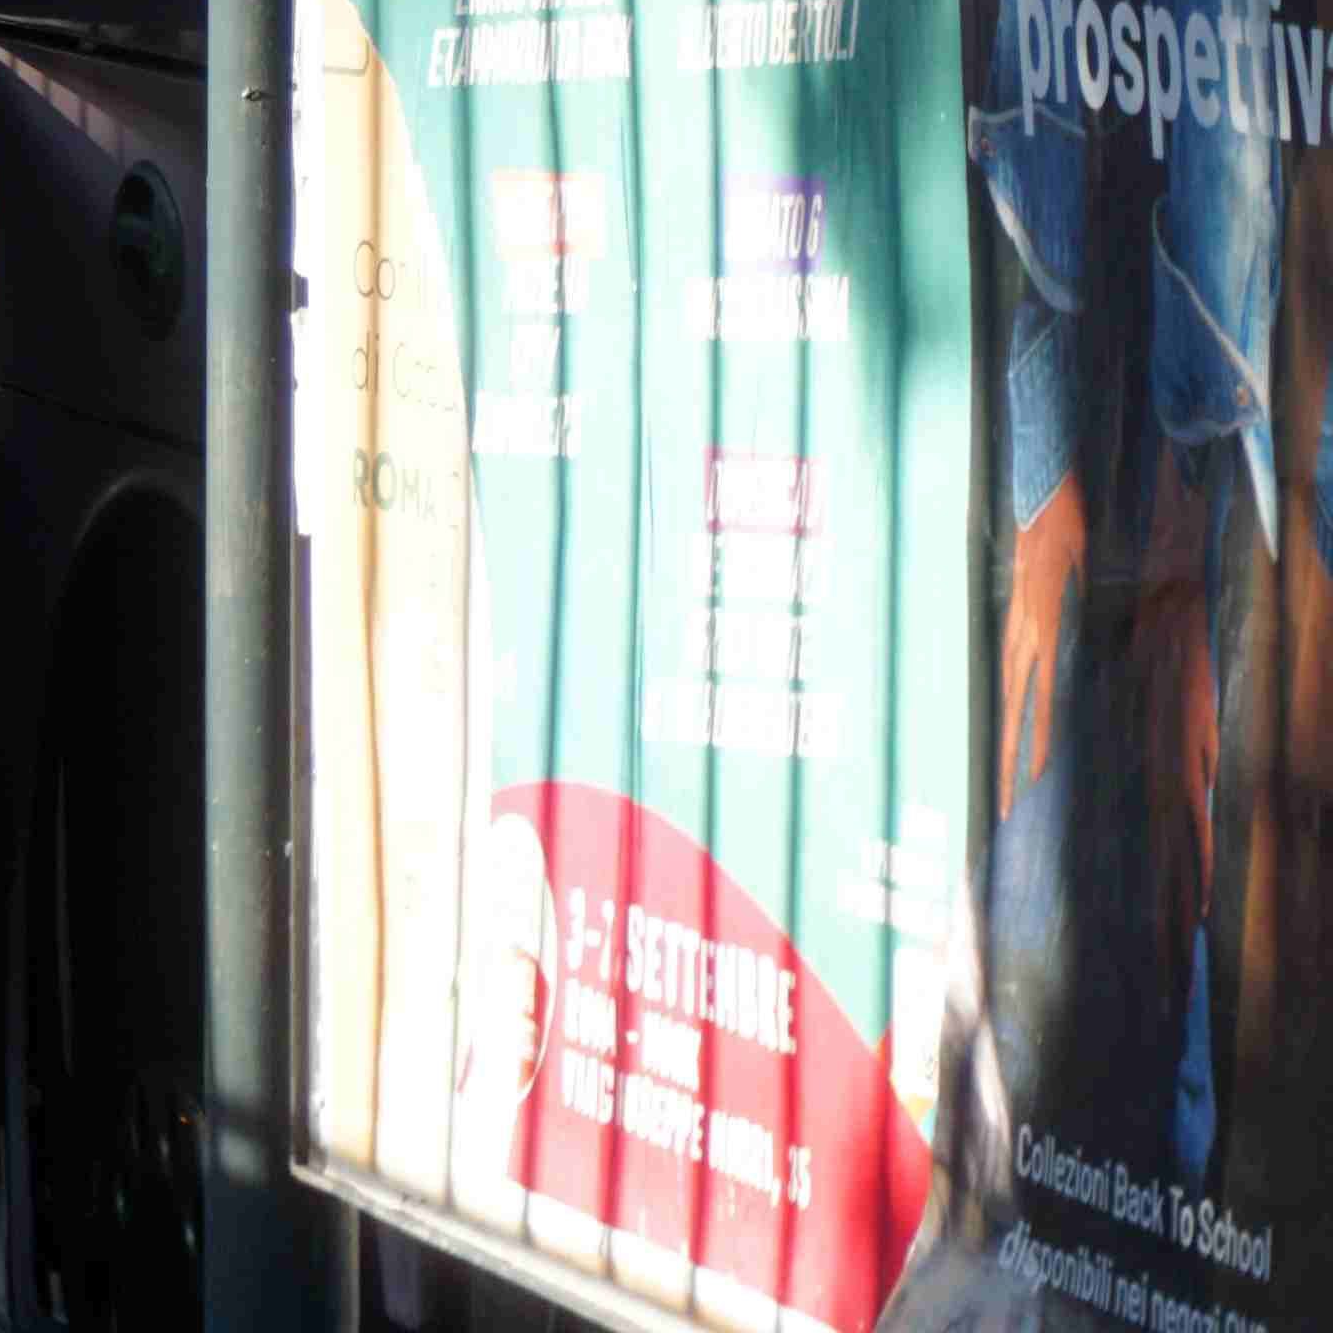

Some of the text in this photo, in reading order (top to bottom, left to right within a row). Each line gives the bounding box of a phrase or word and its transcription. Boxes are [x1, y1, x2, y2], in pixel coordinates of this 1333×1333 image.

[1017, 1124, 1272, 1280] Collezioni Back To School
[998, 1218, 1112, 1312] disponibili
[1115, 1273, 1149, 1326] nei
